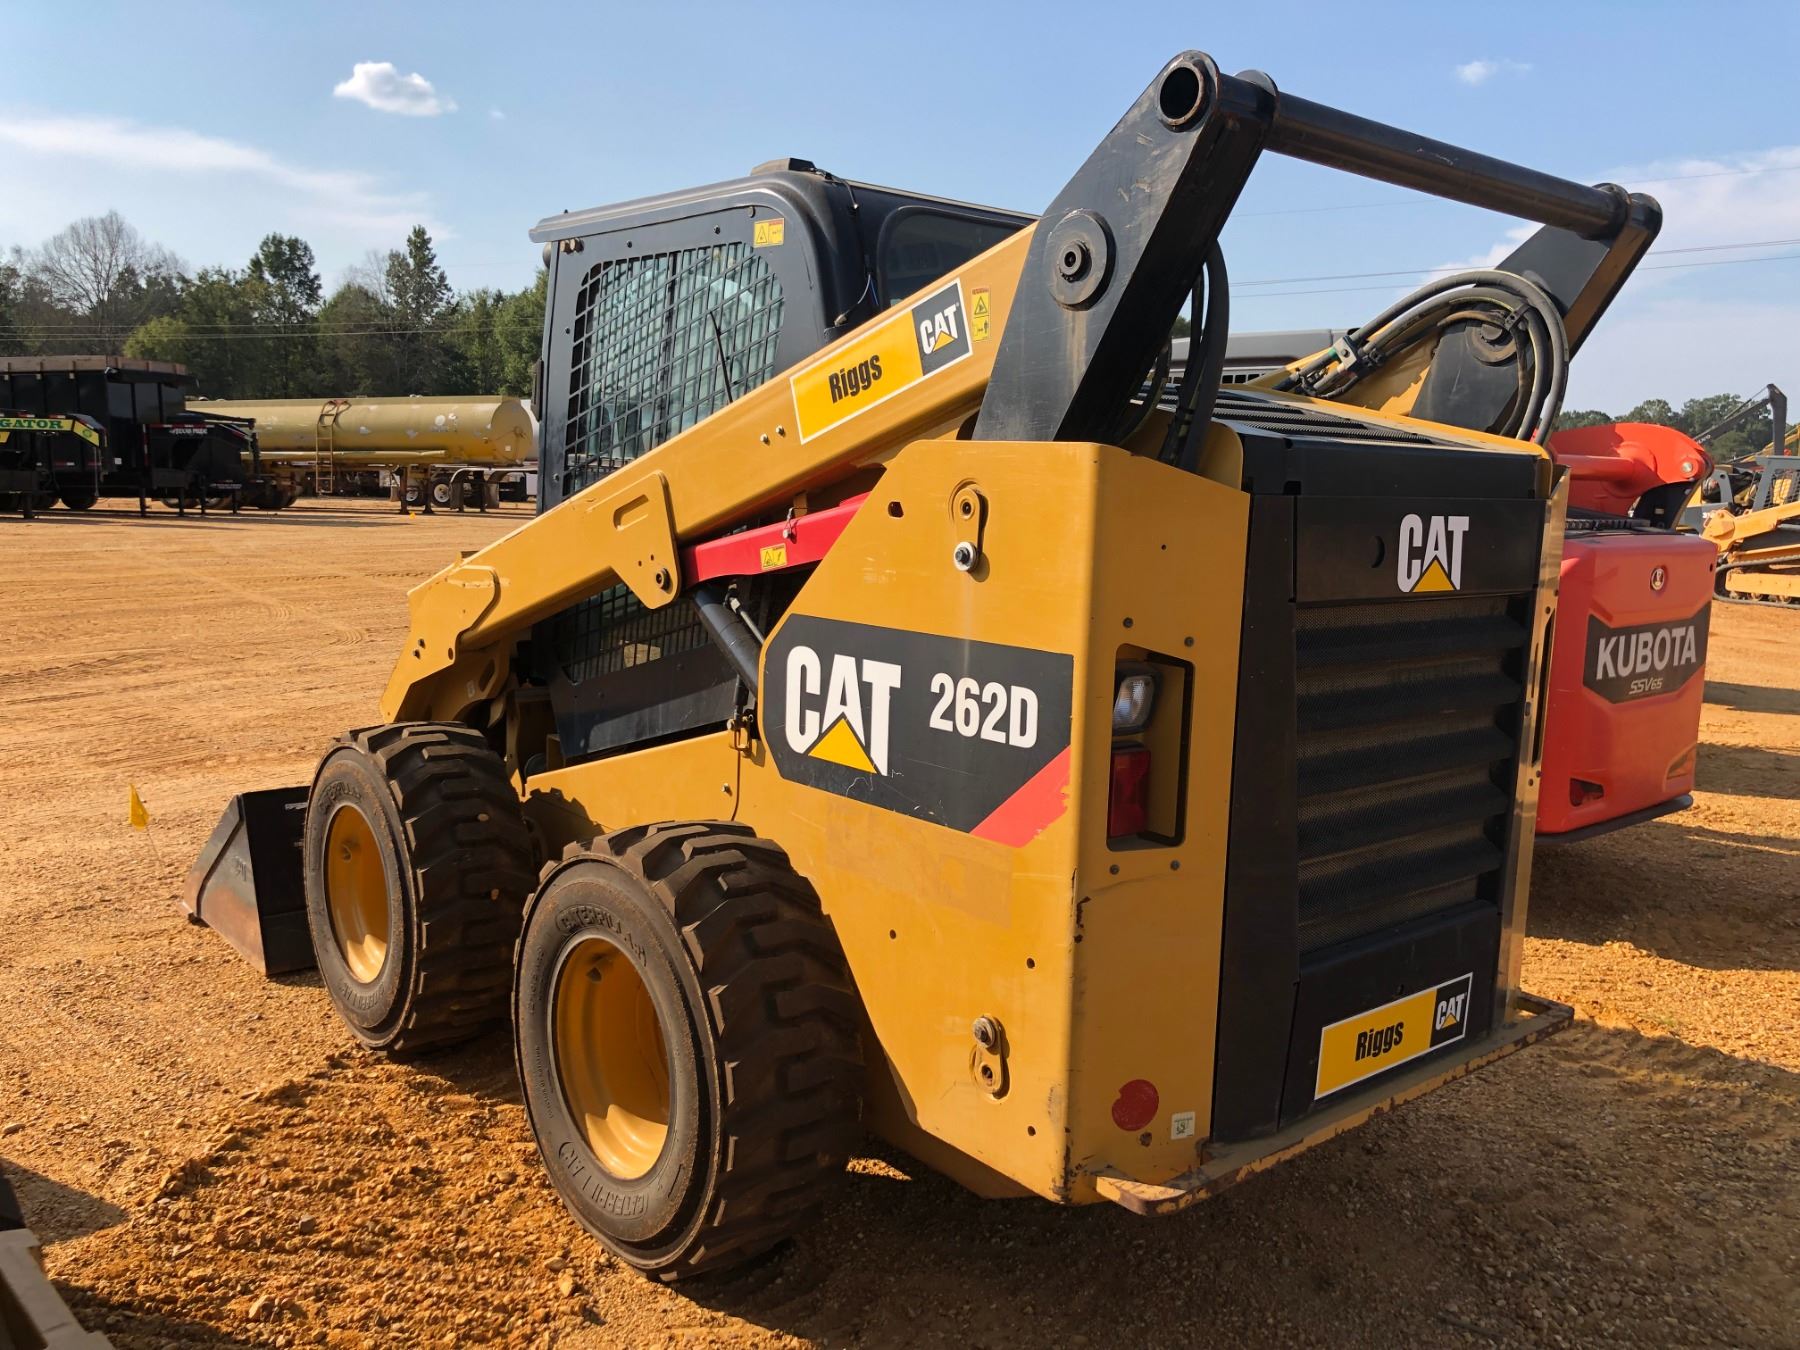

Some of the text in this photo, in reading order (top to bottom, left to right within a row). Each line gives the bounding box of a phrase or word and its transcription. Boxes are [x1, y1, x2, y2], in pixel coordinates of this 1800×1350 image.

[827, 306, 959, 404] Riggs CAT
[1397, 513, 1470, 593] CAT
[1596, 625, 1697, 680] KUBOTA
[1628, 677, 1664, 695] SSV65
[784, 645, 1039, 777] CAT 262D
[1355, 993, 1465, 1062] Riggs CAT
